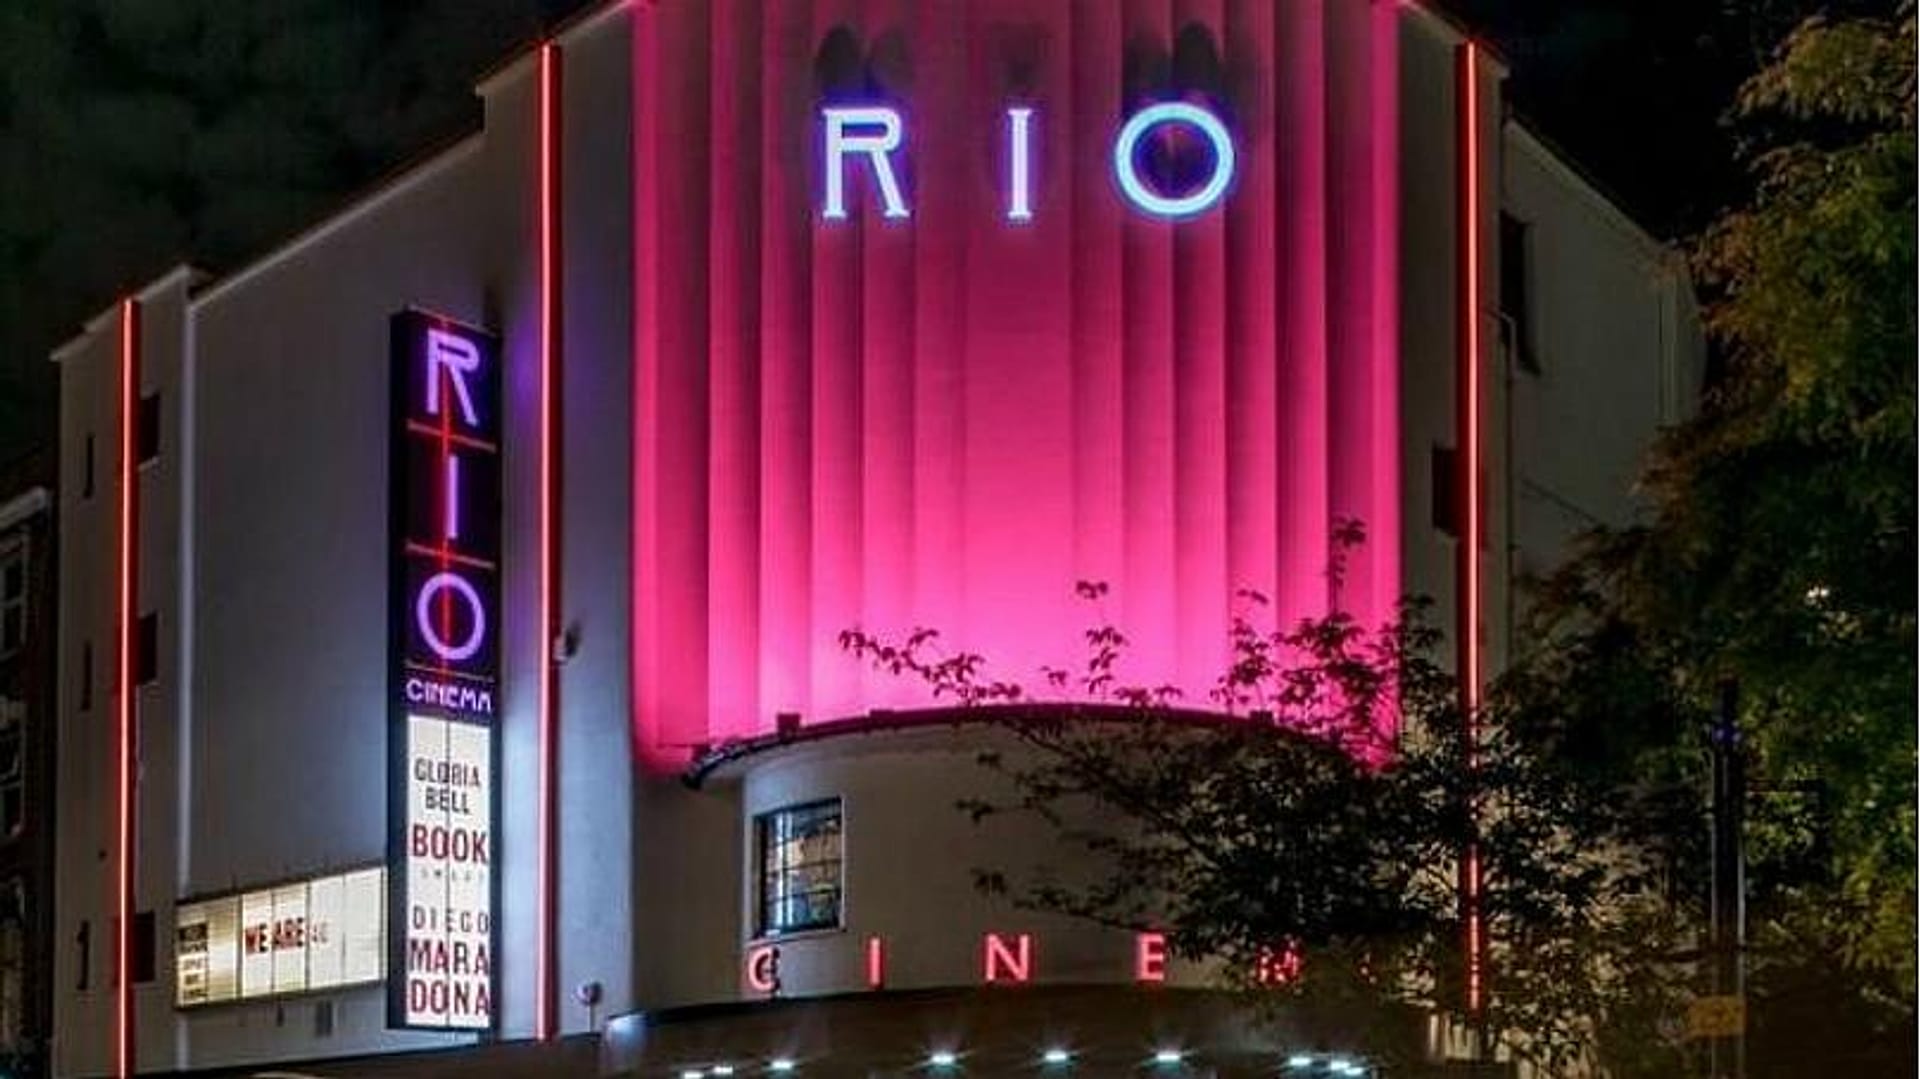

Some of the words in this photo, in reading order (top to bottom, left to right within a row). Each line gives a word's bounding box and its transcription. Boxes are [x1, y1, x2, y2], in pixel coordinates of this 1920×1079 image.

[822, 102, 1235, 218] RIO
[416, 328, 486, 661] RIO
[406, 679, 492, 713] CINEMA
[414, 757, 481, 787] GLORIA
[425, 786, 470, 814] BELL
[412, 824, 489, 863] BOOK
[245, 922, 268, 955] WE
[272, 917, 305, 951] ARE
[412, 906, 489, 934] DIEGO
[409, 938, 490, 975] MARA
[411, 979, 490, 1016] DONA
